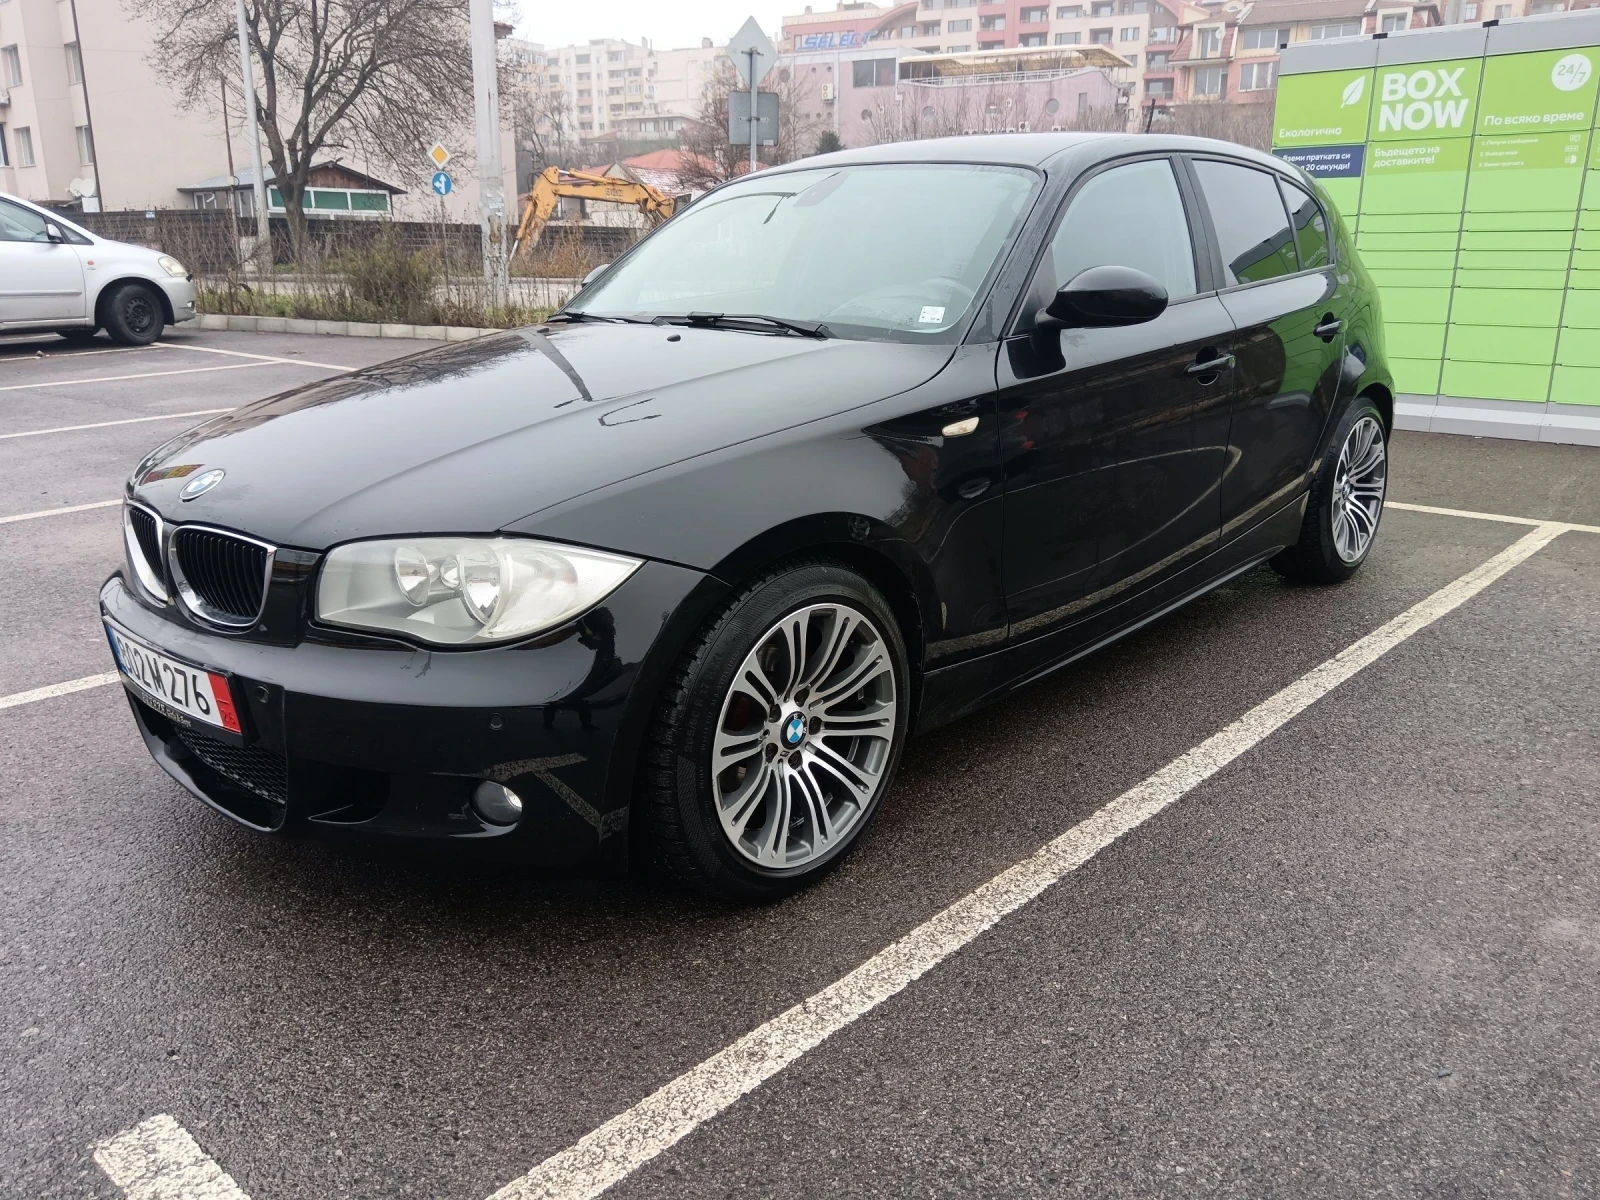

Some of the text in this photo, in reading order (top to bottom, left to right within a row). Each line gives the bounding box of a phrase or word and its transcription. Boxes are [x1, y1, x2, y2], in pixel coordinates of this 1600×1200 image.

[801, 31, 878, 51] SELECT
[1557, 62, 1587, 85] 24/7
[1382, 67, 1466, 102] BOX
[1378, 98, 1470, 132] NOW
[1484, 112, 1585, 126] По всяко време
[1279, 127, 1342, 138] Екологично
[1305, 153, 1341, 162] пратката
[1341, 152, 1351, 160] си
[1374, 147, 1426, 158] Бъдещето
[1305, 163, 1316, 171] 20
[1316, 161, 1350, 172] секунди!
[1373, 155, 1435, 168] доставките!
